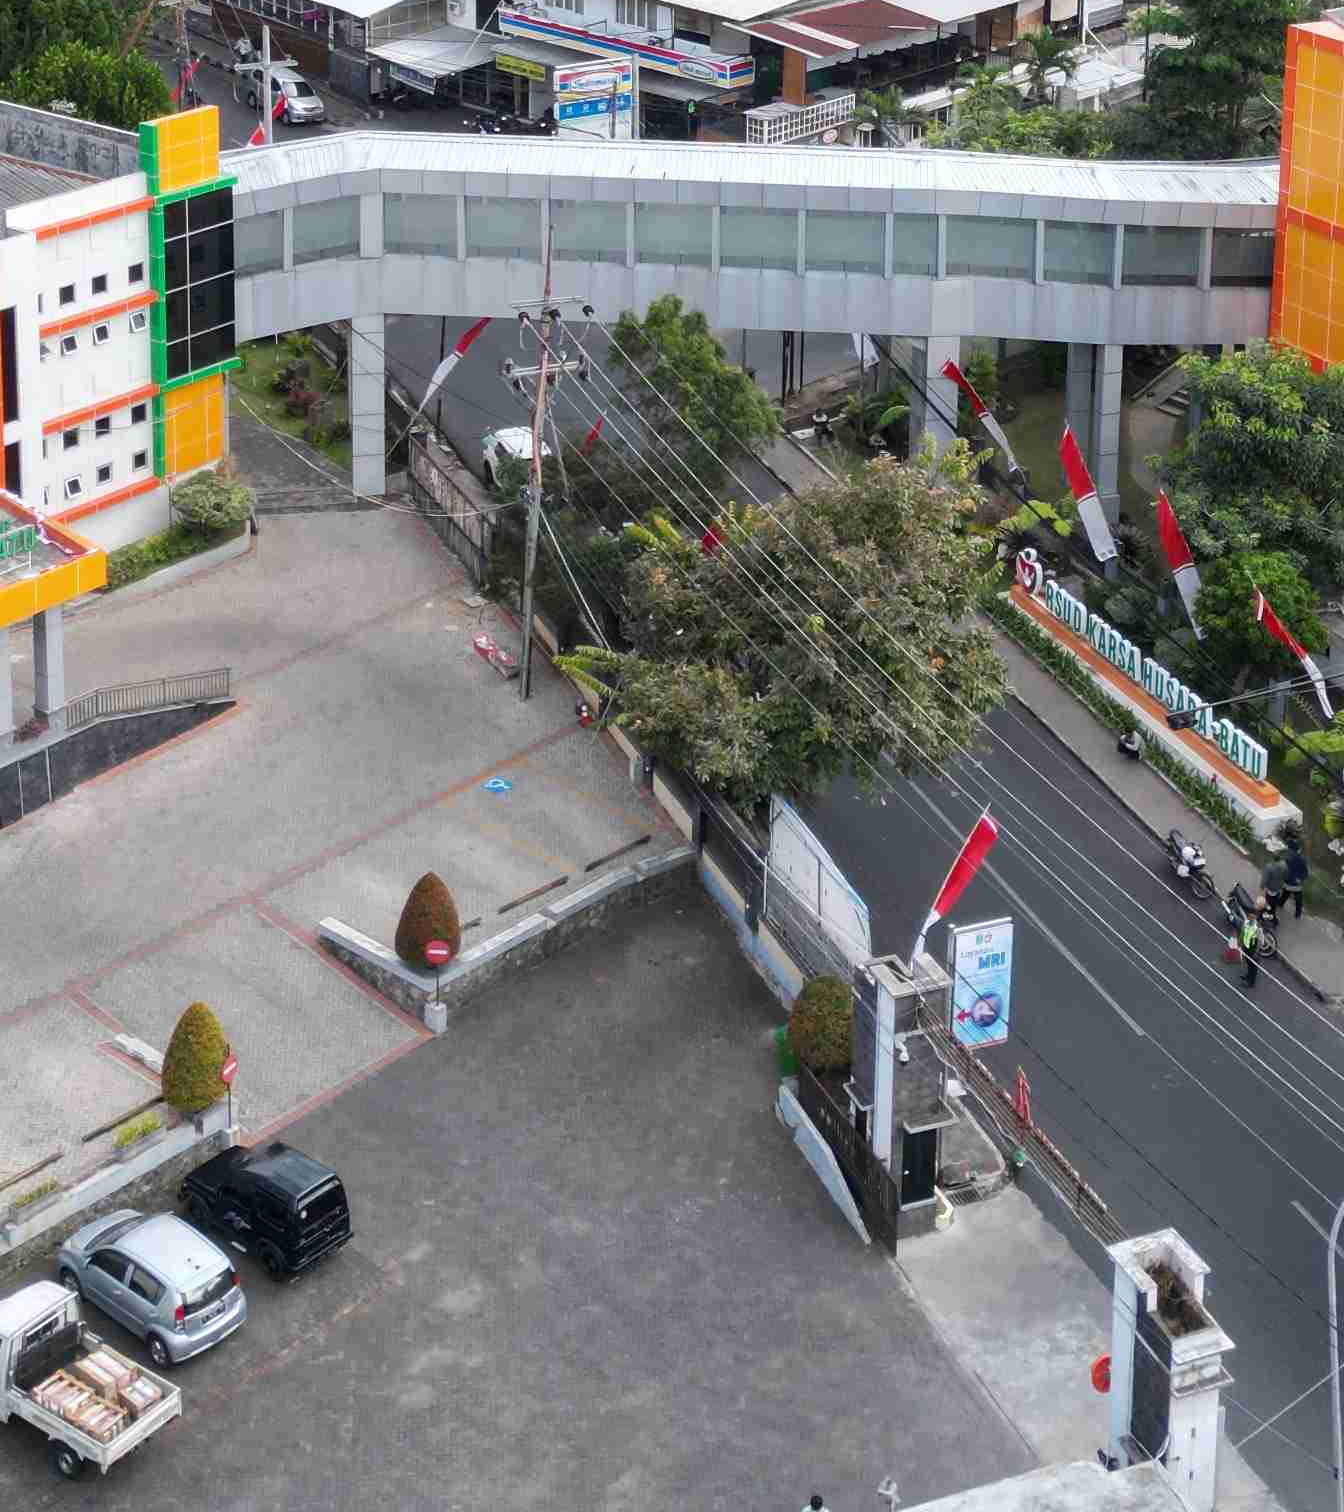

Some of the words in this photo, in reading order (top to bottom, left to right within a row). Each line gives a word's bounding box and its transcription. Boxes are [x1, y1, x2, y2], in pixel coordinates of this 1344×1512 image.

[1045, 580, 1087, 635] RSUD
[1087, 614, 1141, 682] KARSA
[1141, 657, 1213, 738] HUSADA
[1219, 718, 1268, 781] BATU
[978, 952, 1006, 970] MRI
